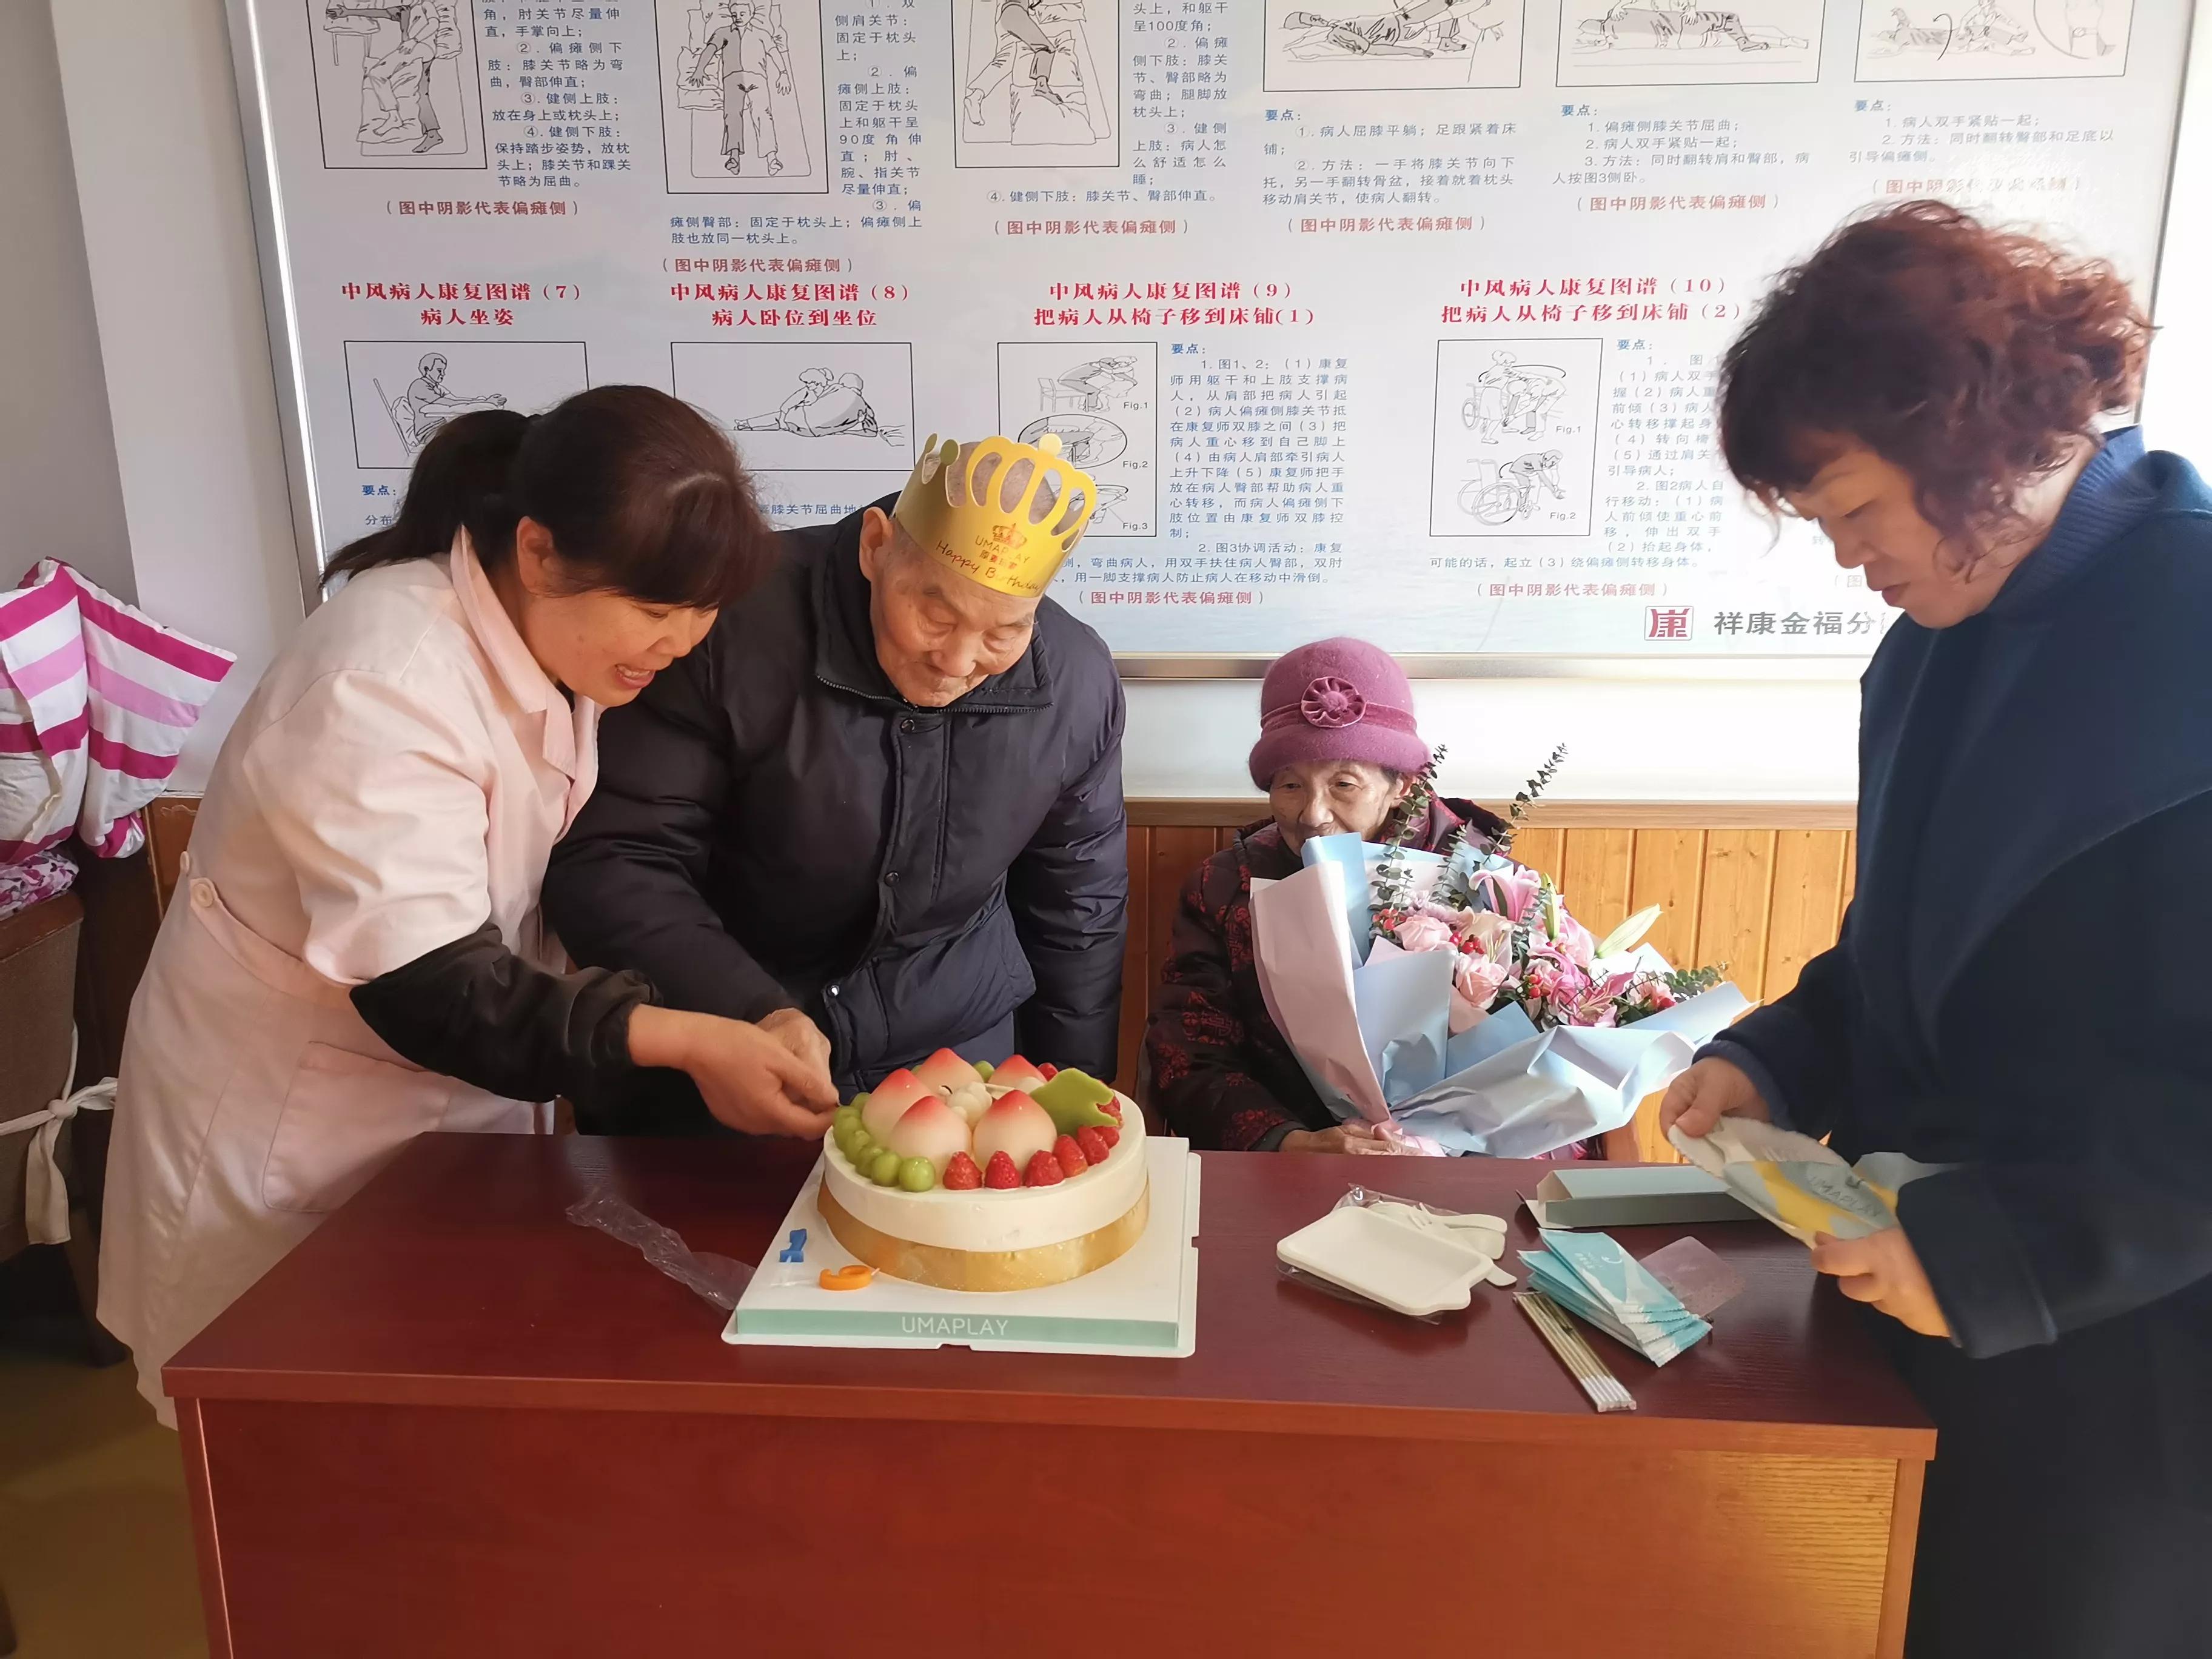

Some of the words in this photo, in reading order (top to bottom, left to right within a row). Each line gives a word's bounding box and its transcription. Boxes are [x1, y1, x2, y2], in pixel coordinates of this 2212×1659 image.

[483, 8, 620, 21] 角，肘关节尽量伸
[836, 32, 916, 44] 固定于枕头
[839, 99, 918, 112] 固定于枕头
[1561, 104, 1598, 117] 要点：
[1265, 109, 1301, 121] 要点：
[839, 117, 919, 129] 上和躯干呈
[1133, 156, 1226, 169] 么舒适怎么
[386, 201, 578, 216] （图中阴影代表偏瘫侧）
[1578, 194, 1779, 212] （图中阴影代表偏瘫侧）
[994, 220, 1188, 235] （图中阴影代表偏瘫侧）
[1288, 216, 1486, 233] （图中阴影代表偏瘫侧）
[662, 258, 853, 273] （图中阴影代表偏瘫侧）
[341, 282, 581, 302] 中风病人康复图谱（7）
[671, 283, 908, 302] 中风病人康复图谱（8）
[1049, 281, 1291, 301] 中风病人康复图谱（9）
[1460, 276, 1726, 298] 中风病人康复图谱（10）
[421, 308, 514, 326] 病人坐姿
[712, 309, 877, 327] 病人卧位到坐位
[1171, 343, 1205, 354] 要点：
[1170, 374, 1347, 386] 师用躯干和上肢支撑病
[1123, 401, 1149, 412] Fig.1
[1555, 425, 1581, 435] Fig.1
[1170, 436, 1346, 447] 病人重心移到自己脚上
[1122, 460, 1148, 471] Fig.2
[362, 485, 396, 495] 要点：
[760, 504, 864, 515] 膝关节屈曲地
[1550, 512, 1576, 521] Fig.2
[1122, 521, 1148, 532] Fig.3
[975, 535, 1030, 564] UMAPAY
[936, 540, 980, 574] Happy
[1053, 572, 1329, 584] ，用一脚支撑病人防止病人在移动中滑倒。
[1478, 583, 1667, 598] （图中阴影代表偏瘫侧）
[1079, 591, 1264, 605] （图中阴影代表偏瘫侧）
[1714, 611, 1888, 635] 祥康金福分
[902, 1316, 1008, 1335] UMAPLAY
